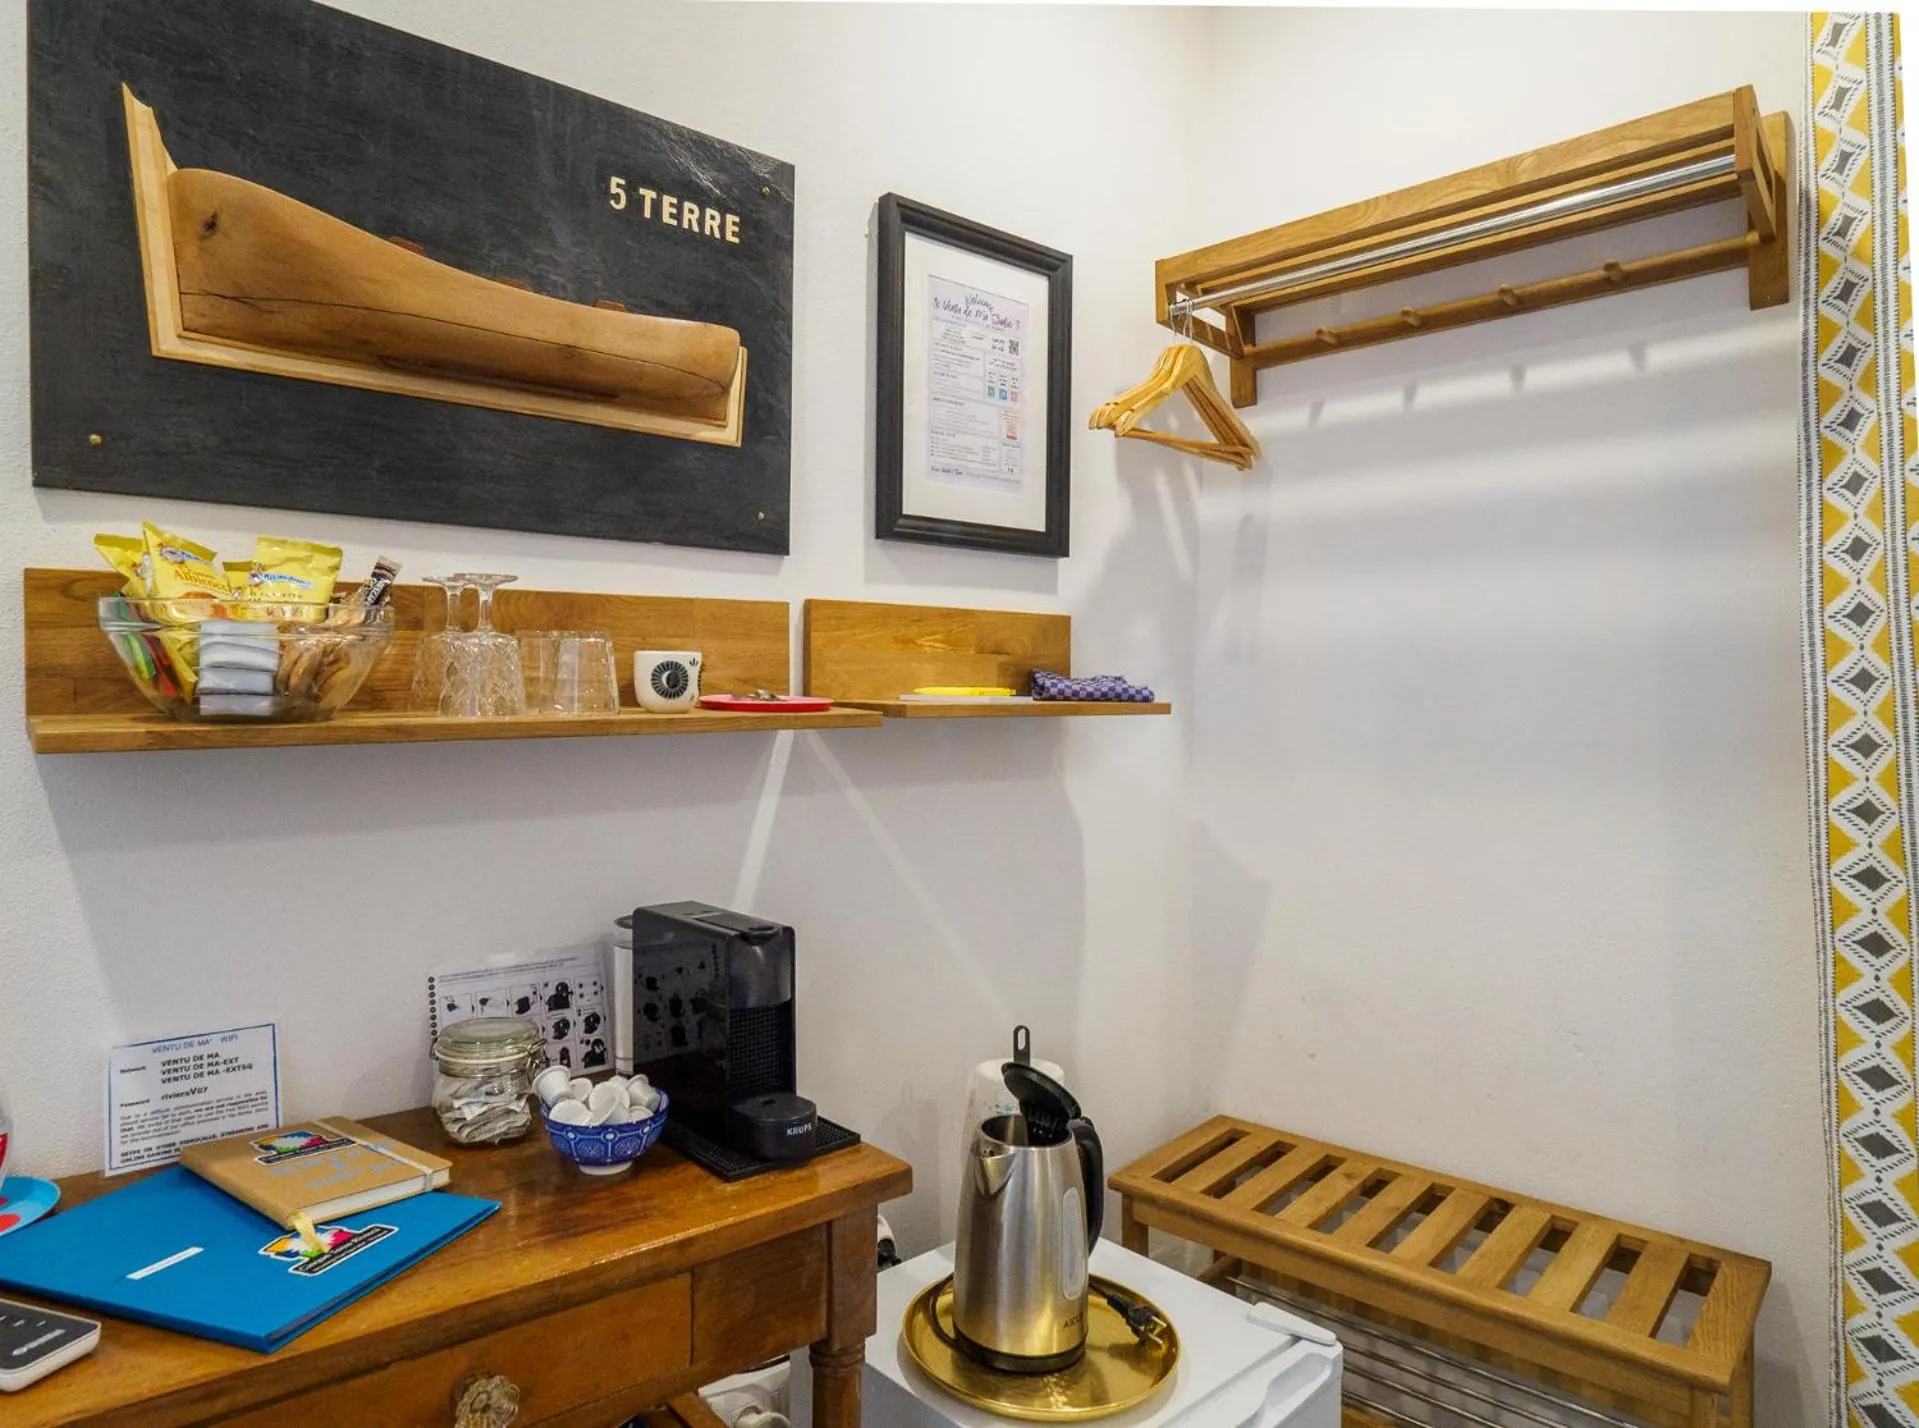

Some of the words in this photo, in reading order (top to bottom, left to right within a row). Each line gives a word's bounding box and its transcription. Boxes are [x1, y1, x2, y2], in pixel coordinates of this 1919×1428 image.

[609, 176, 627, 210] 5
[639, 187, 741, 245] TERRE
[152, 1042, 181, 1054] VENTU
[183, 1040, 194, 1049] DE
[160, 1056, 189, 1066] VENTU
[206, 1051, 219, 1059] MA
[160, 1064, 190, 1075] VENTU
[192, 1062, 204, 1070] DE
[161, 1073, 190, 1084] VENTU
[207, 1068, 219, 1076] MA
[786, 1123, 812, 1136] KRUPS
